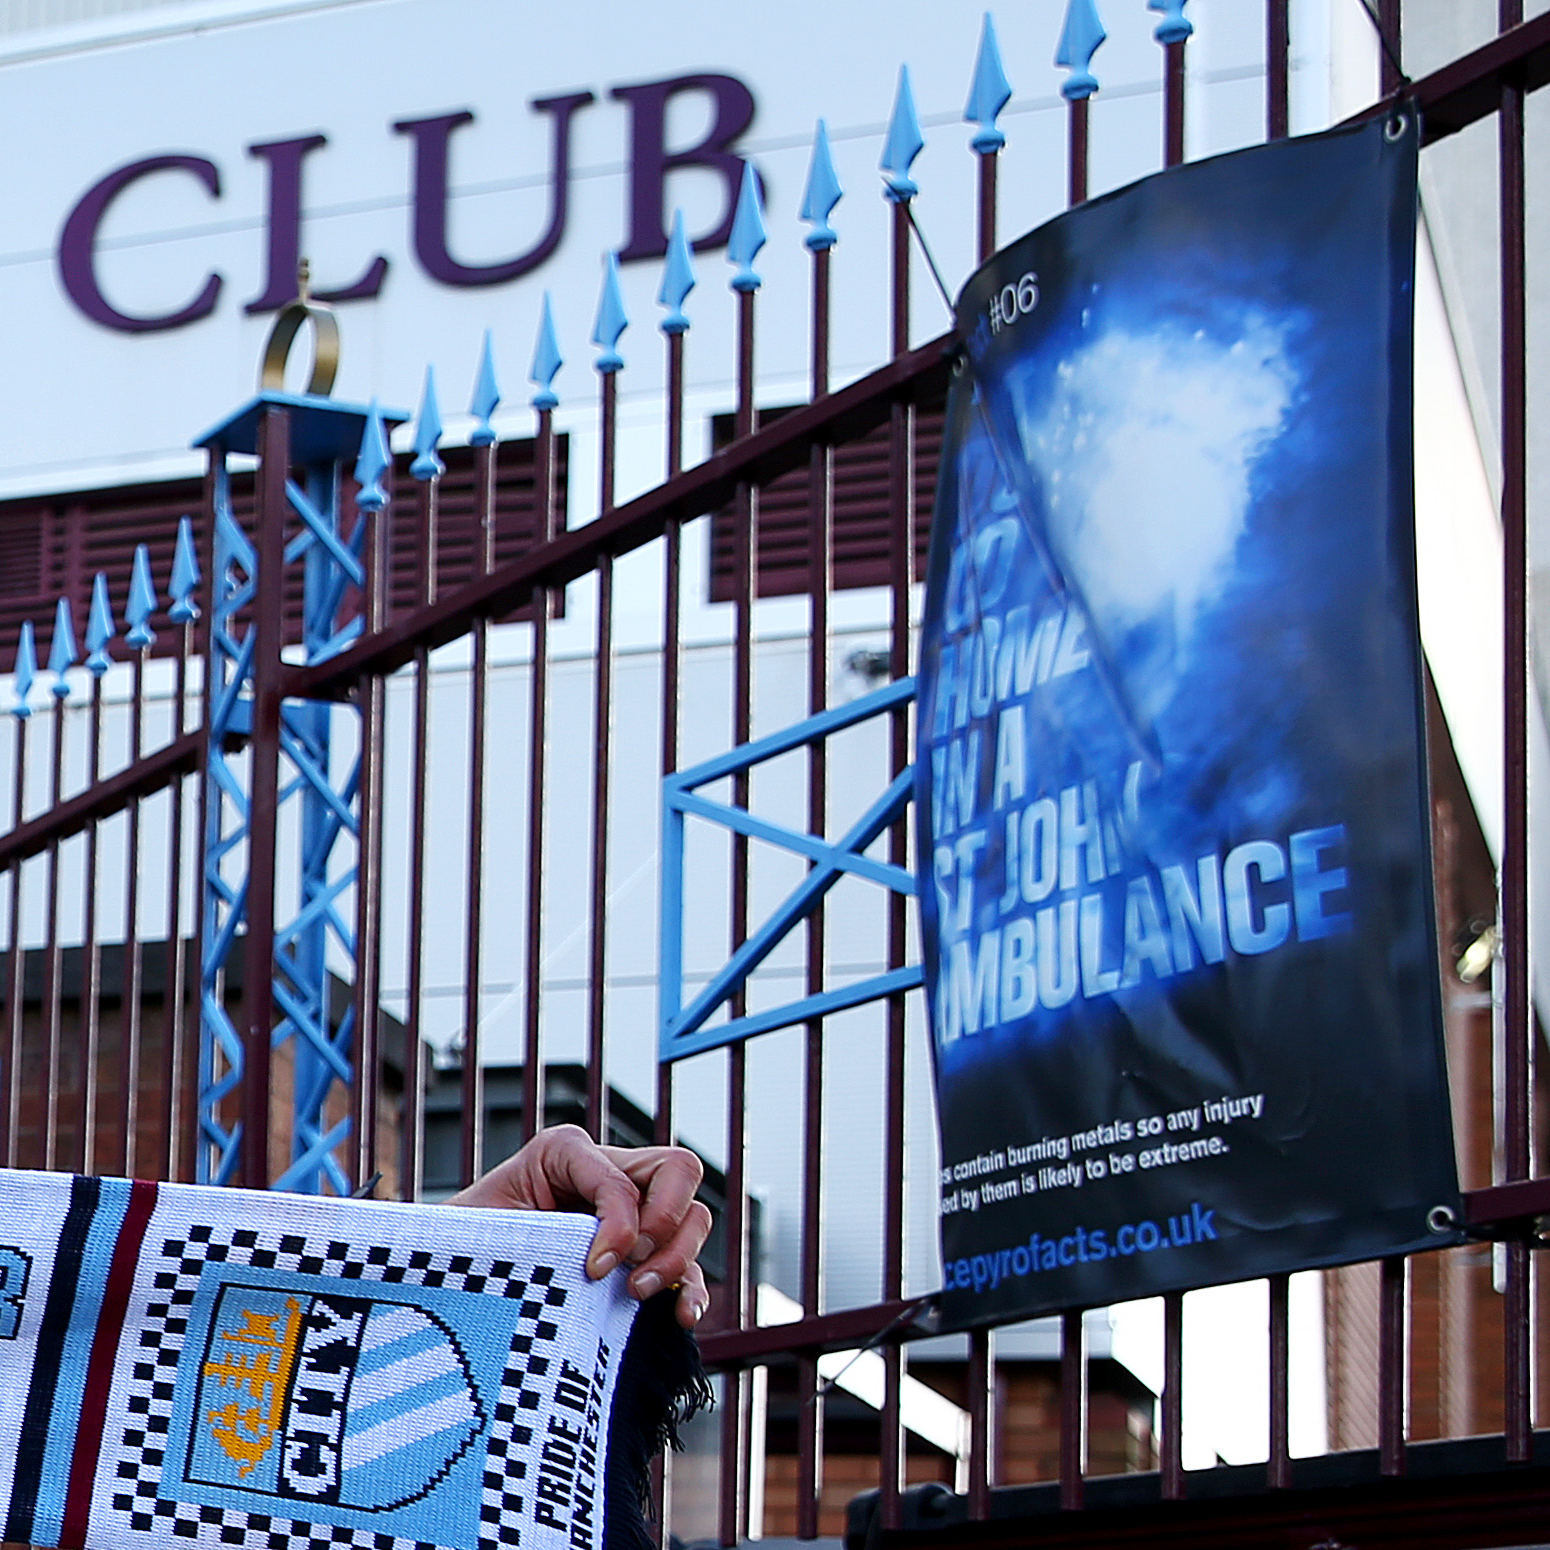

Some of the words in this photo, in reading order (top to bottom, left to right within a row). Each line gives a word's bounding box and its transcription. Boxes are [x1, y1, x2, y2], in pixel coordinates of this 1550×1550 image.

[56, 70, 763, 333] CLUB
[989, 271, 1039, 335] #06
[993, 704, 1026, 813] A
[953, 1150, 1006, 1181] contain
[1007, 1135, 1068, 1168] burning
[1071, 1118, 1134, 1152] metals
[1136, 1116, 1165, 1138] so
[1167, 1106, 1201, 1131] any
[1203, 1093, 1265, 1125] injury
[961, 1187, 980, 1212] by
[981, 1178, 1020, 1205] them
[1021, 1171, 1038, 1195] is
[1039, 1162, 1084, 1191] likely
[1085, 1158, 1107, 1180] to
[1109, 1150, 1137, 1176] be
[1138, 1134, 1231, 1170] extreme.
[282, 1299, 363, 1496] CITY
[554, 1359, 591, 1414] OF
[536, 1415, 584, 1532] PRIDE
